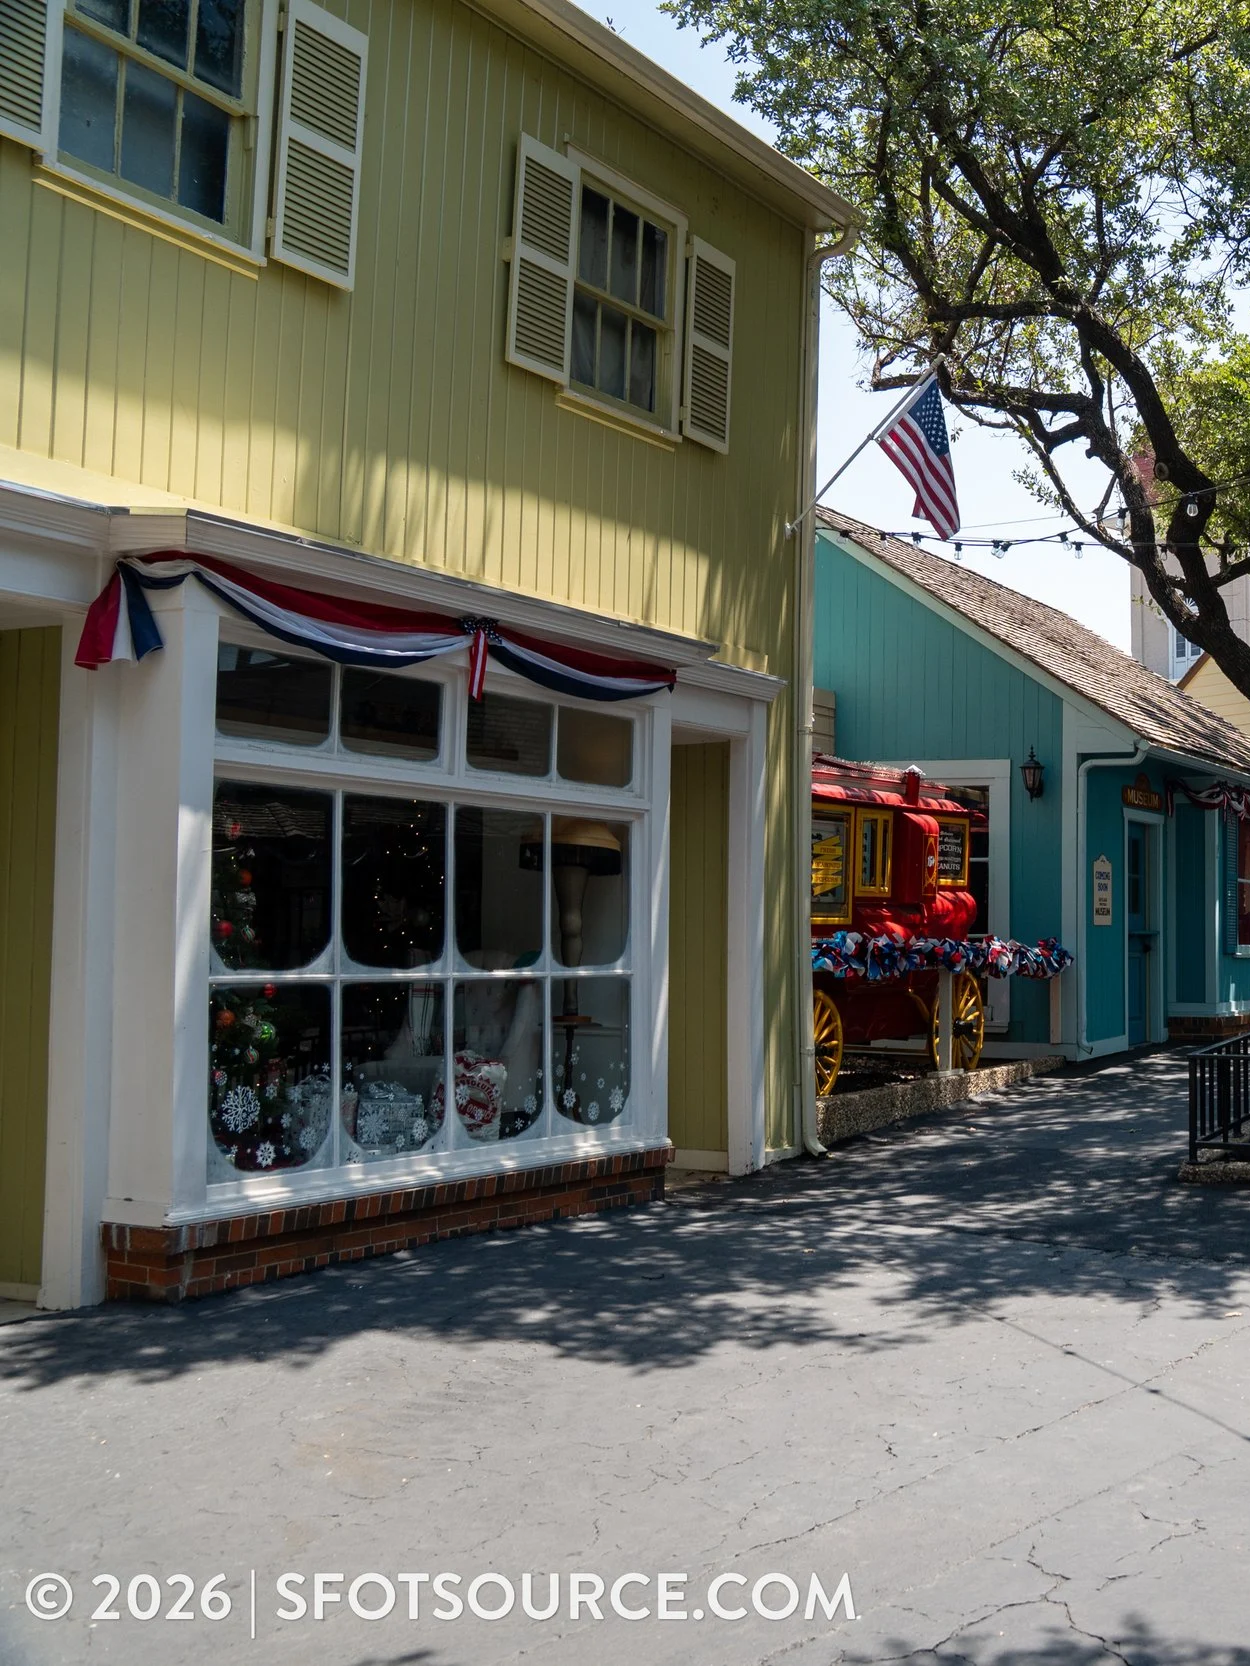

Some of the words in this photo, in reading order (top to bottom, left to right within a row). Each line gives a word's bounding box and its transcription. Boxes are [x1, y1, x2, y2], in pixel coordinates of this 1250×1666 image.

[1127, 788, 1159, 808] MUSEUM
[938, 844, 962, 854] PCORN
[1095, 907, 1110, 916] MUSEUM
